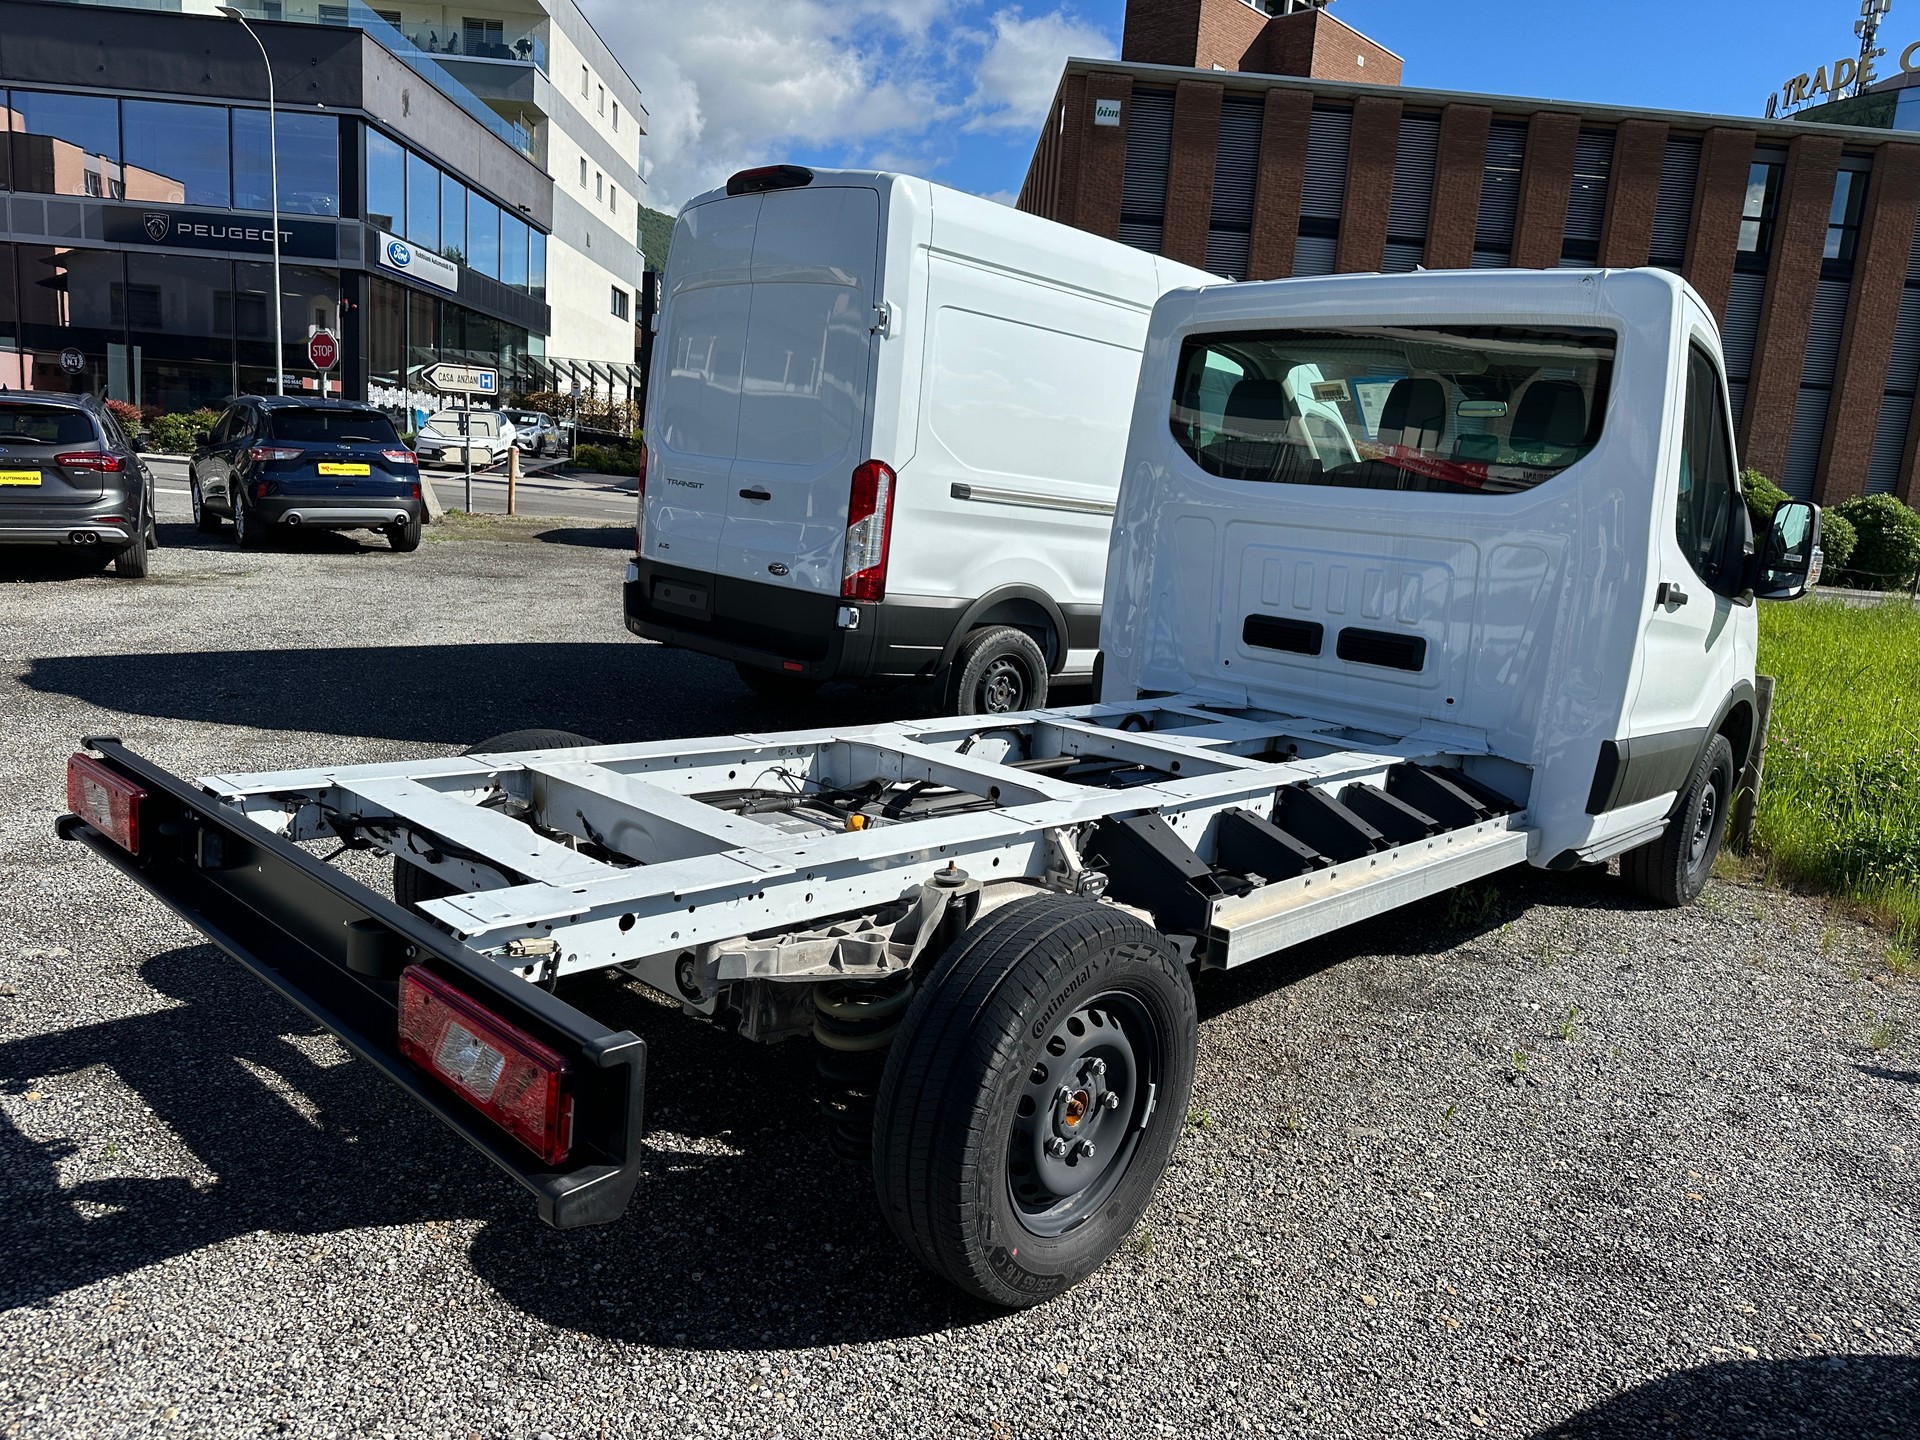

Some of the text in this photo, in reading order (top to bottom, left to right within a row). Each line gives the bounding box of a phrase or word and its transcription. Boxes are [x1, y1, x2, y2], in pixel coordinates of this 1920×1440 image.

[1781, 50, 1878, 110] TRADE
[1097, 106, 1119, 118] bim
[177, 223, 293, 243] PEUGEOT
[393, 243, 409, 263] Ford
[312, 345, 333, 357] STOP
[438, 372, 454, 383] CASA
[457, 374, 479, 385] ANZIANI
[666, 478, 705, 489] TRANSIT
[1031, 965, 1092, 1040] Continental
[1020, 1275, 1058, 1292] 235/65
